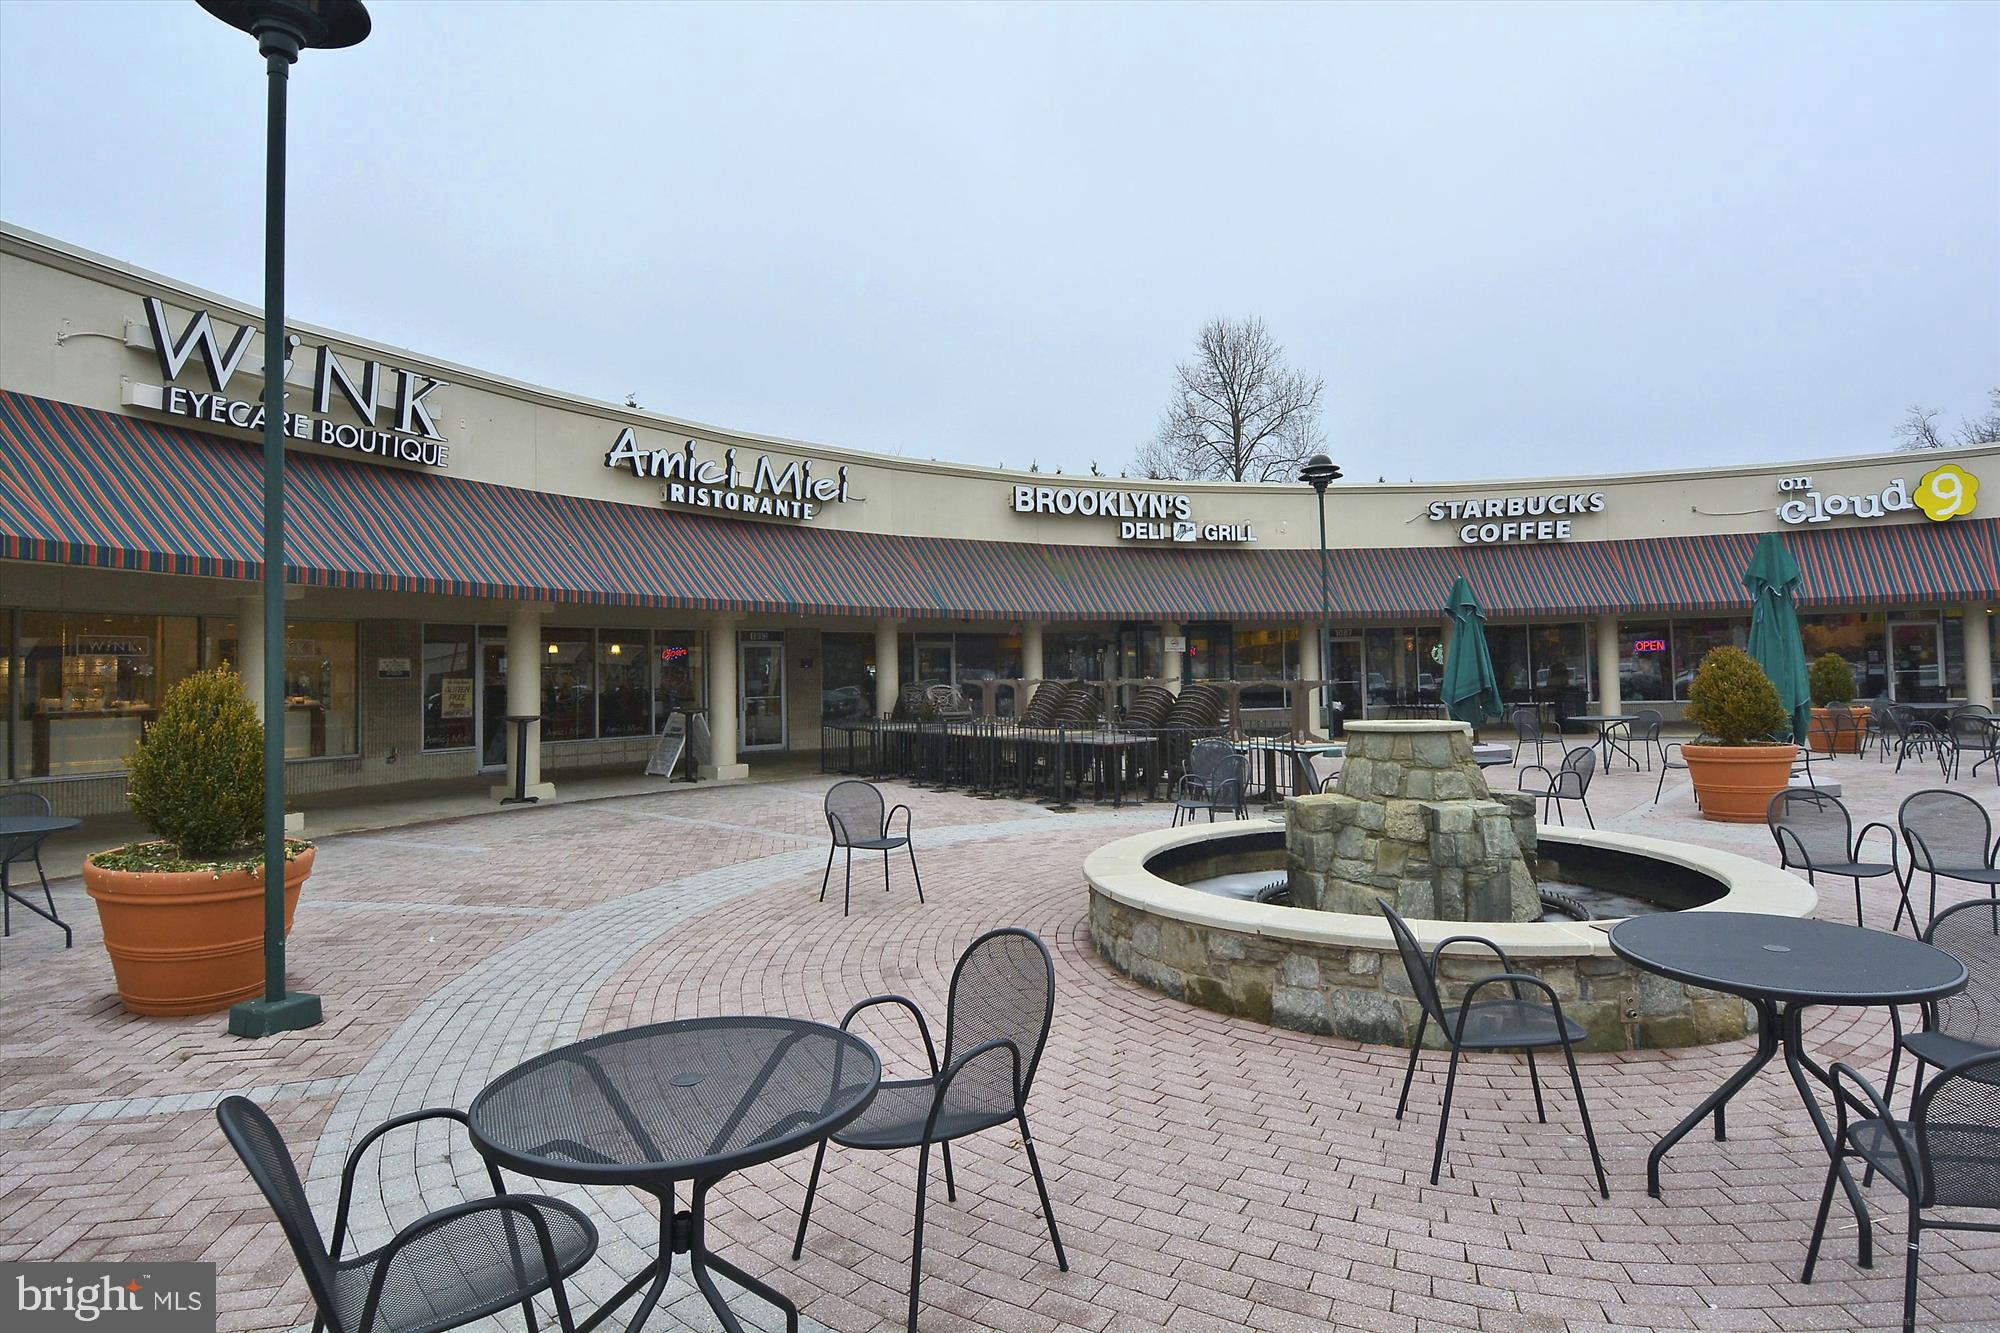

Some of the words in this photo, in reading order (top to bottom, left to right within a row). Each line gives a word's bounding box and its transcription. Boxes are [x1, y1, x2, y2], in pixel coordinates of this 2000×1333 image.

[320, 419, 450, 469] BOUTIQUE
[605, 427, 738, 490] Amici
[753, 455, 850, 503] Miei
[1780, 475, 1813, 491] on
[1780, 478, 1914, 525] cloud
[1931, 472, 1964, 516] 9
[669, 483, 814, 521] RISTORANTE
[1014, 485, 1193, 521] BROOKLYN'S
[1429, 492, 1606, 522] STARBUCKS
[1120, 521, 1166, 540] DELI
[1203, 524, 1258, 542] GRILL
[1459, 520, 1572, 544] COFFEE
[1635, 640, 1665, 652] OPEN
